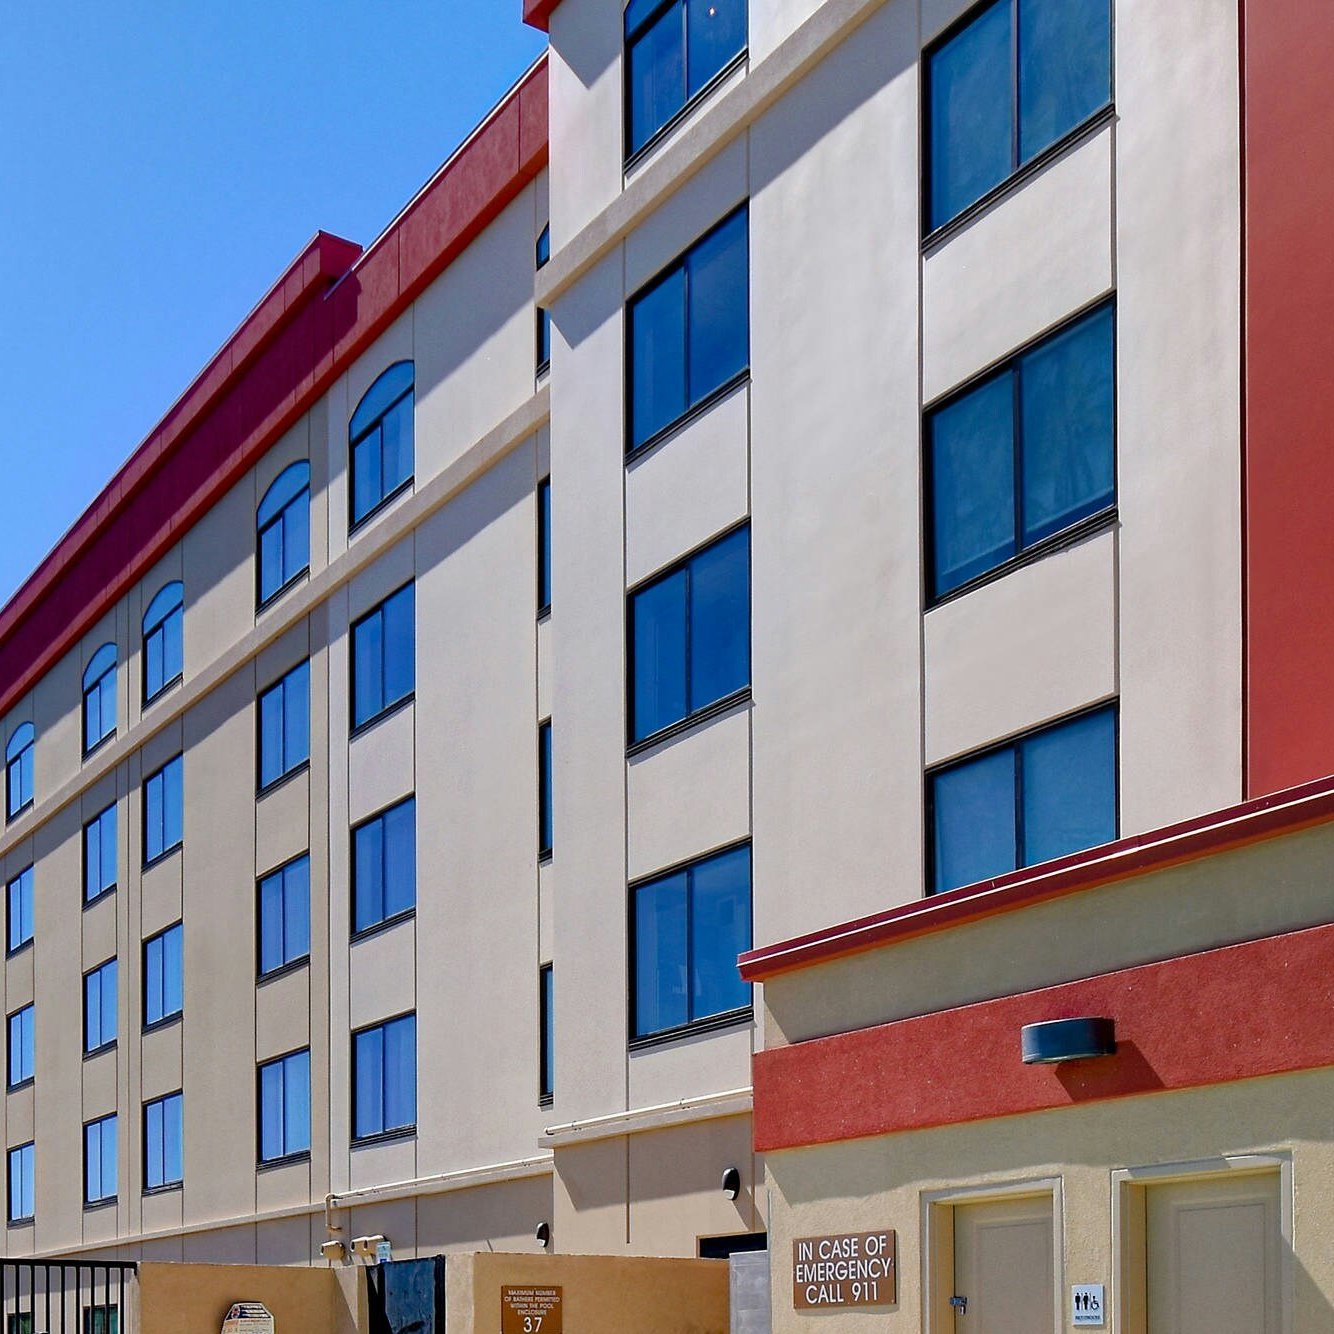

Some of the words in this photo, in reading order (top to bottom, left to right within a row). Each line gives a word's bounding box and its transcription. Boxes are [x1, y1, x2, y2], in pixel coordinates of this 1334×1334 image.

[798, 1242, 813, 1261] IN
[818, 1237, 859, 1259] CASE
[865, 1235, 887, 1256] OF
[796, 1257, 891, 1283] EMERGENCY
[806, 1283, 844, 1304] CALL
[851, 1281, 877, 1302] 911
[523, 1316, 542, 1333] 37
